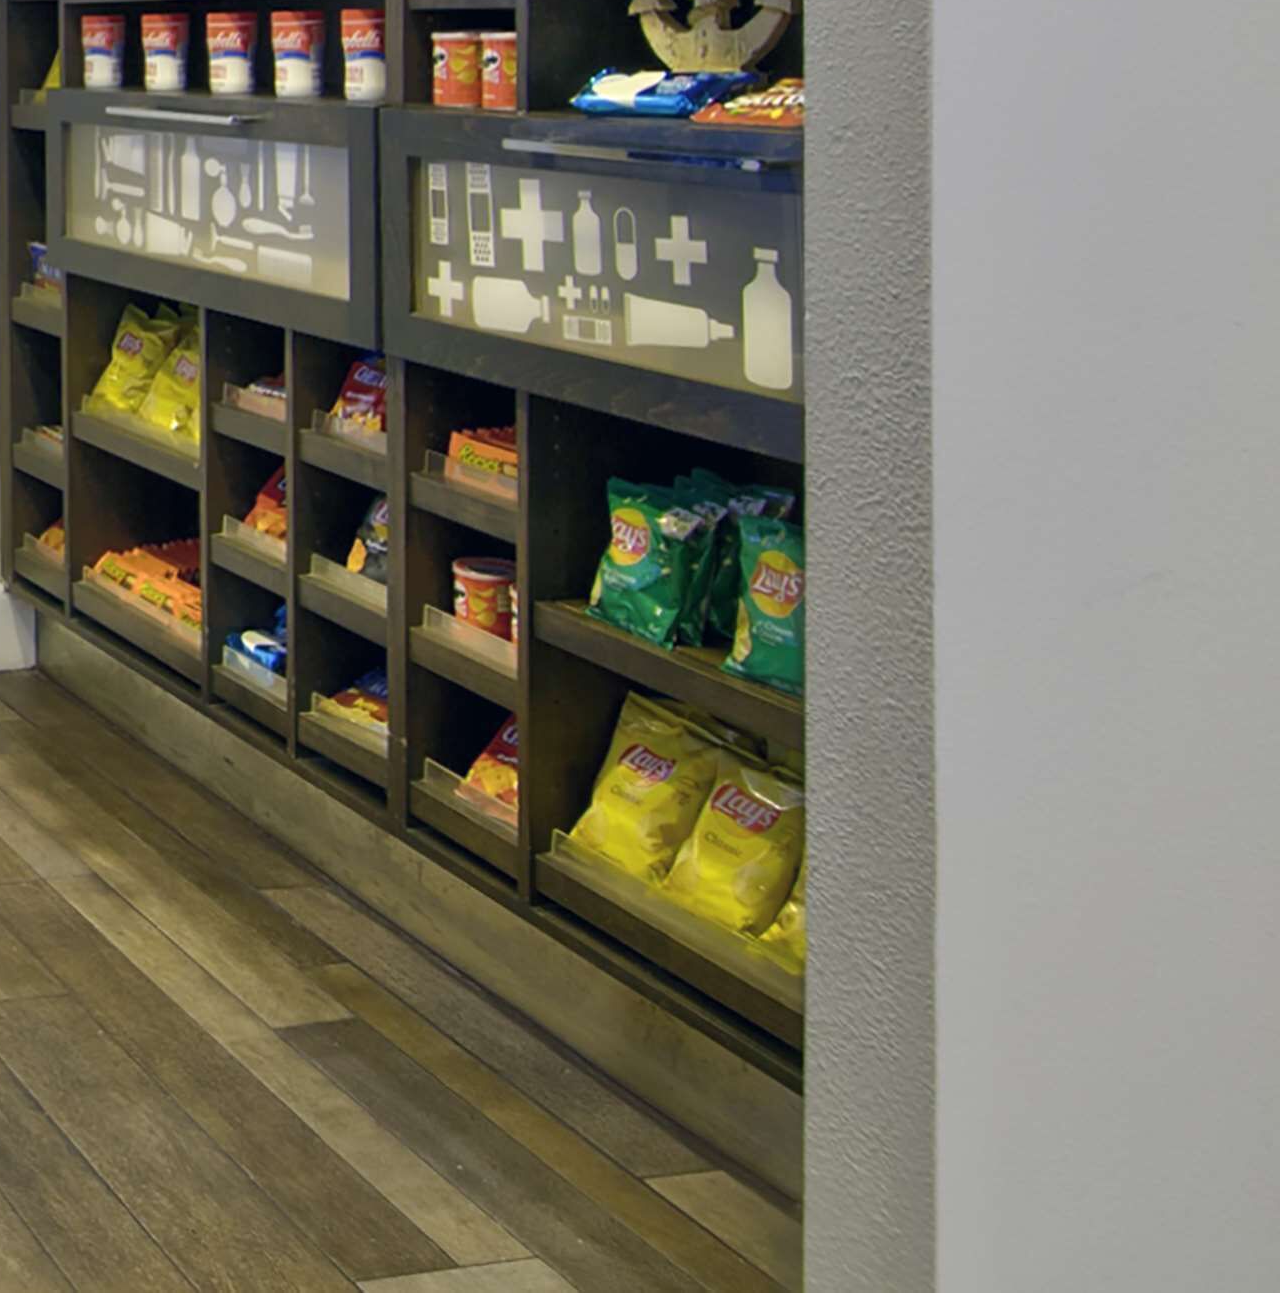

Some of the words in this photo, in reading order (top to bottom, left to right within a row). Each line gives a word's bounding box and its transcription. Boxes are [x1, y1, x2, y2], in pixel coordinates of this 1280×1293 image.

[753, 566, 803, 602] Lay's
[622, 746, 674, 779] Lay's
[714, 786, 779, 829] Lay's
